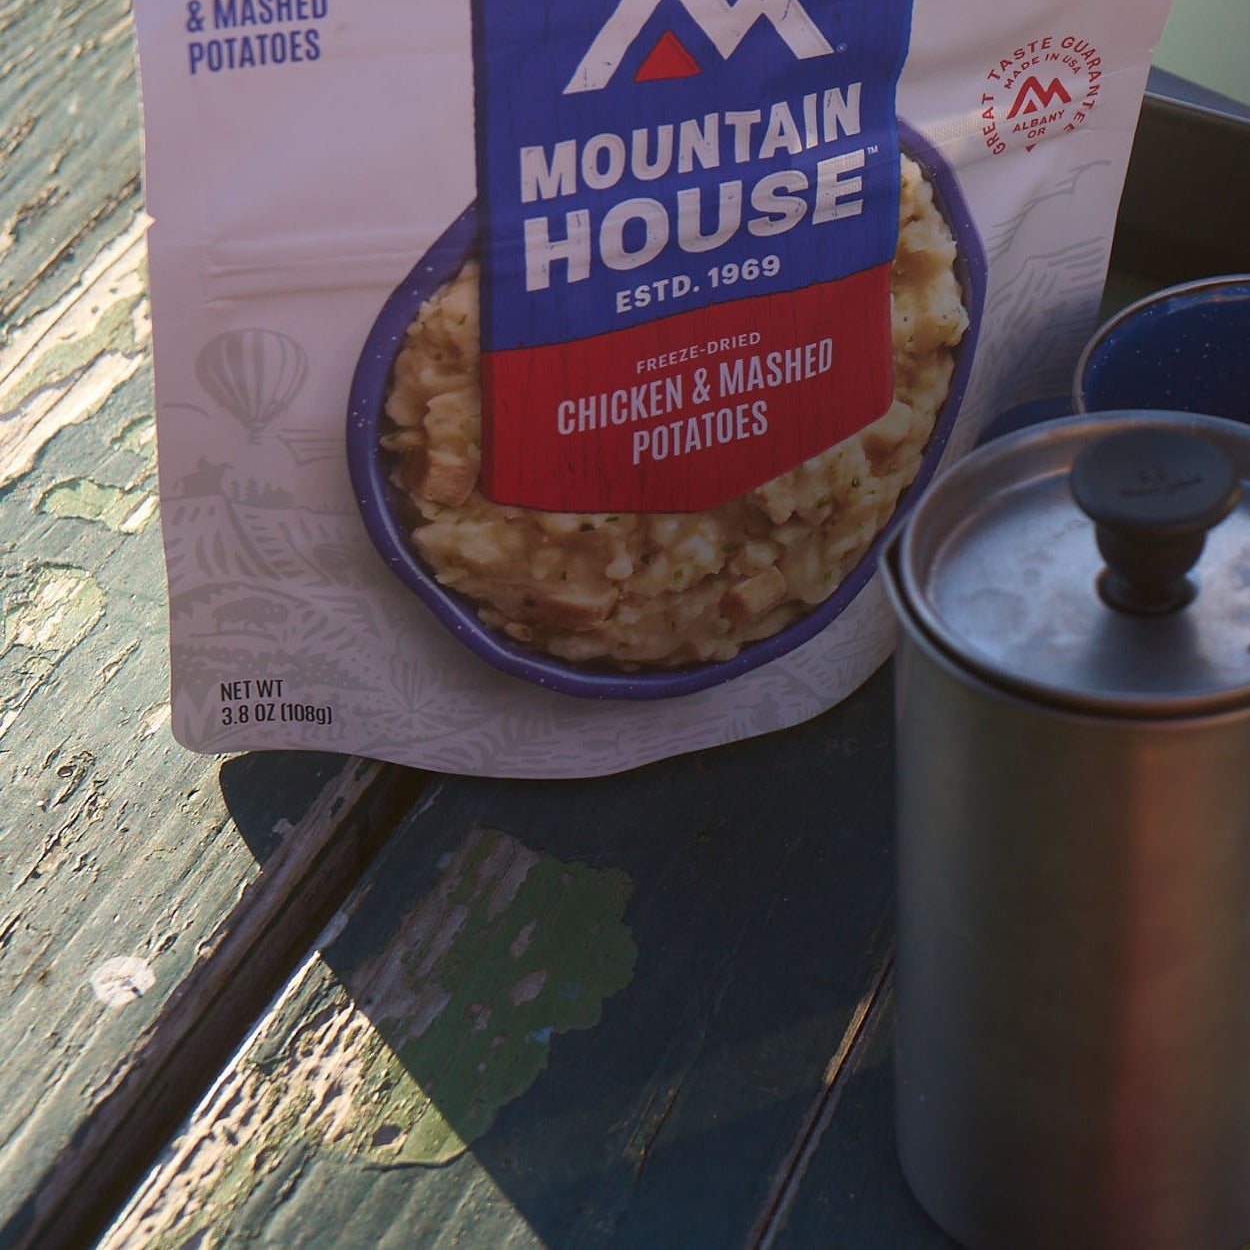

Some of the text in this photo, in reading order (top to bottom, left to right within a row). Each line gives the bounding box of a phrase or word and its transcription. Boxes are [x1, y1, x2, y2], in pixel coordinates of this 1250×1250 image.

[186, 0, 205, 33] &
[189, 28, 321, 75] POTATOES
[1004, 53, 1082, 90] MADE IN USA
[981, 36, 1102, 155] GREAT TASTE GUARANTEE
[519, 82, 862, 203] MOUNTAIN
[1012, 110, 1065, 133] ALBANY
[1027, 127, 1046, 139] OR
[524, 148, 865, 292] HOUSE
[616, 255, 781, 313] ESTD. 1969
[636, 332, 761, 374] FREEZE-DRIED
[557, 338, 832, 435] CHICKEN & MASHED
[632, 400, 768, 466] POTATOES
[220, 679, 284, 701] NET WT
[222, 702, 332, 726] 3.8 OZ (108g)
